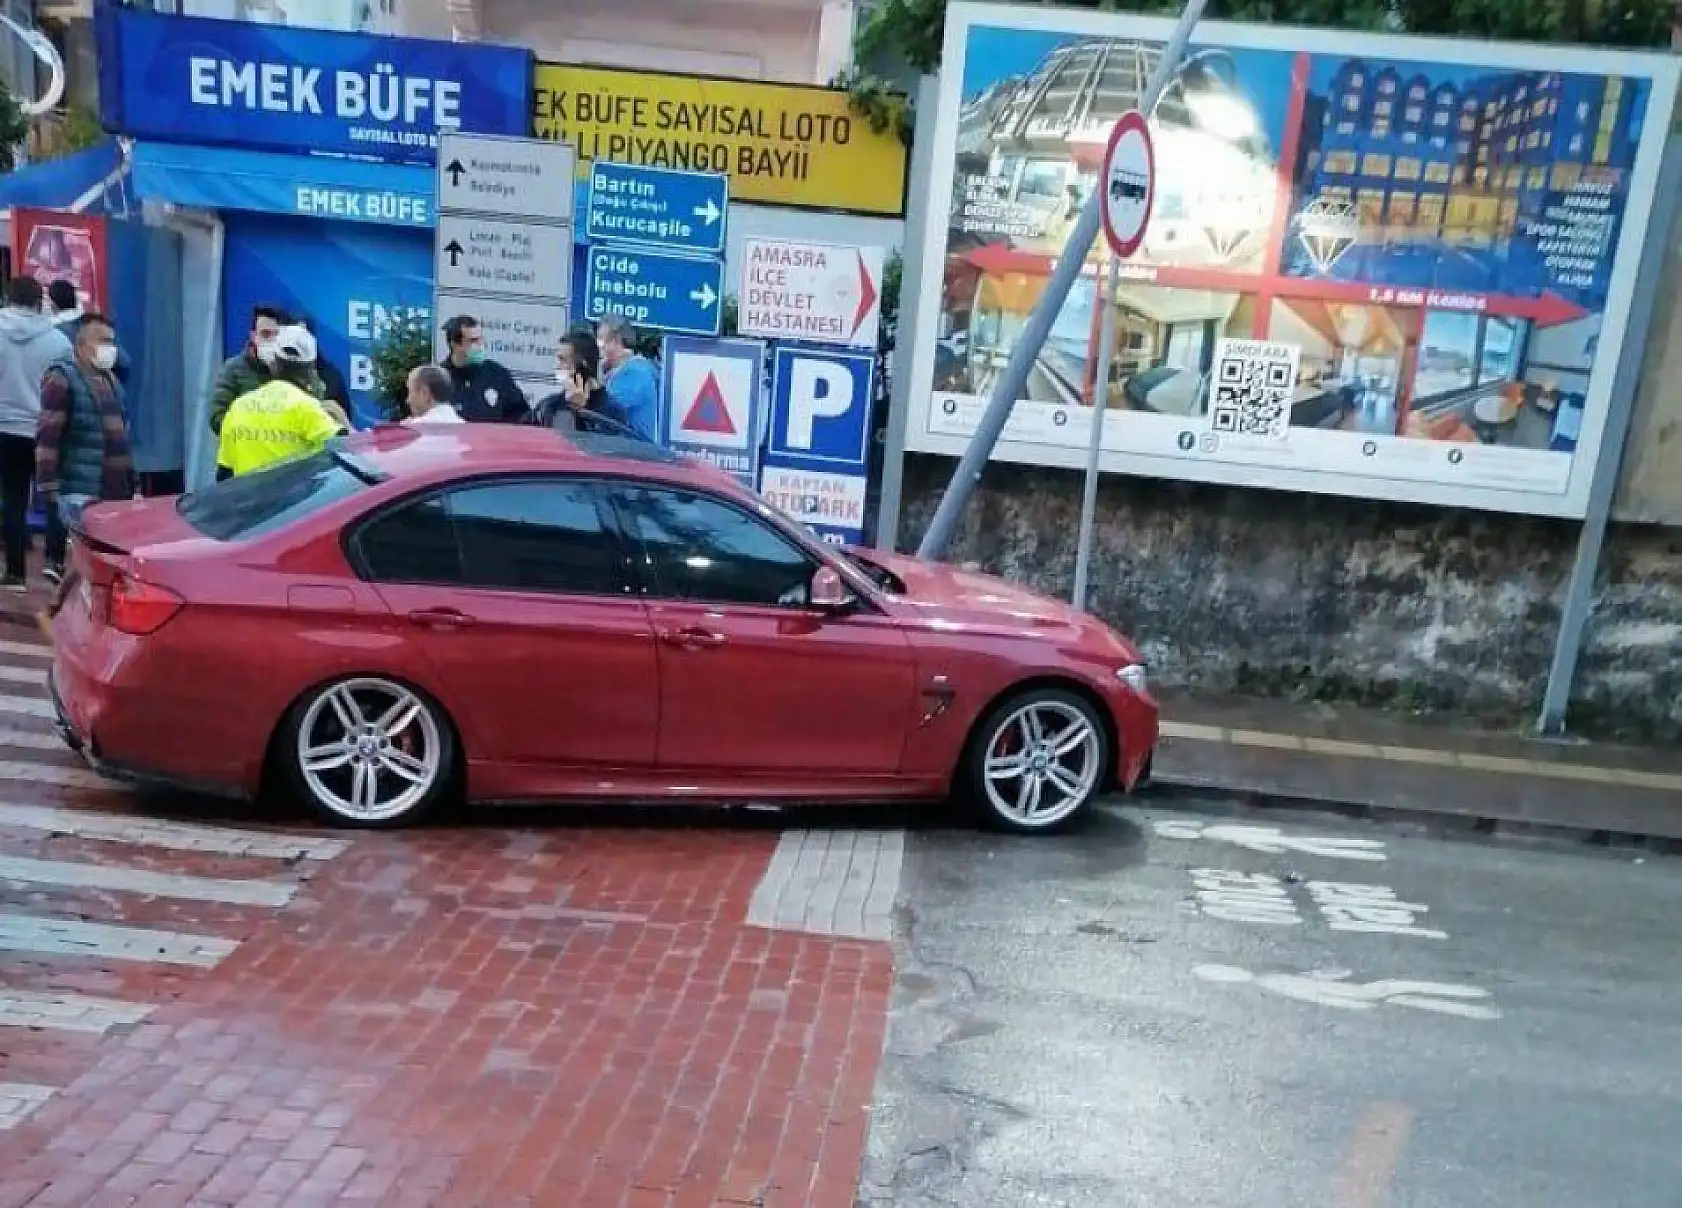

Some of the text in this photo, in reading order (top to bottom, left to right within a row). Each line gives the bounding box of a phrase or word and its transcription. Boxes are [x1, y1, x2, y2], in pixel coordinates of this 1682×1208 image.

[189, 57, 461, 126] EMEK BÜFE
[575, 88, 649, 128] BÜFE
[656, 100, 771, 138] SAYISAL
[779, 110, 850, 145] LOTO
[608, 129, 729, 173] PİYANGO
[738, 143, 809, 181] BAYİİ
[594, 173, 656, 197] Bartın
[297, 186, 427, 223] EMEK BÜFE
[592, 209, 693, 238] Kurucaşile
[595, 253, 640, 276] Cide
[752, 245, 828, 269] AMASRA
[594, 271, 668, 300] İnebolu
[748, 288, 817, 310] DEVLET
[592, 297, 650, 322] Sinop
[786, 356, 854, 450] P
